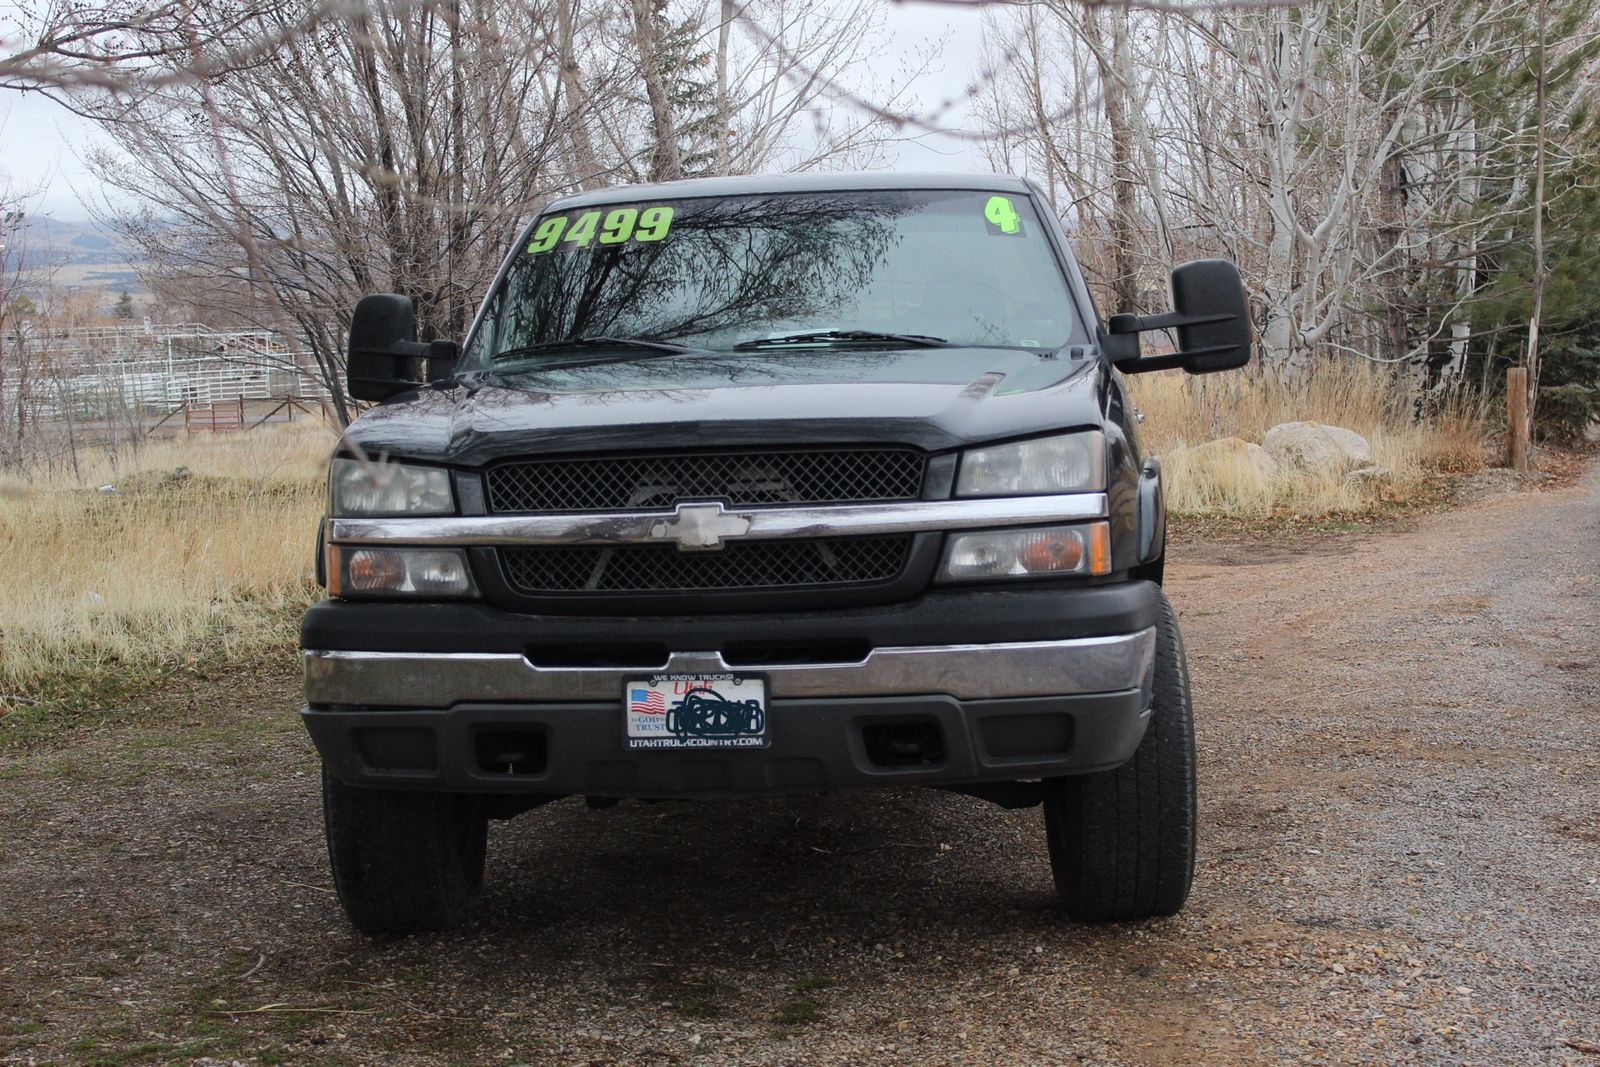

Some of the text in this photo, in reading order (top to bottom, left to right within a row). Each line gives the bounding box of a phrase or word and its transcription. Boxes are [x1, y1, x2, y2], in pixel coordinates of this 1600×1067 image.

[985, 196, 1020, 234] 4
[527, 207, 674, 254] 9499
[673, 680, 713, 695] Utah
[635, 723, 666, 731] TRUST
